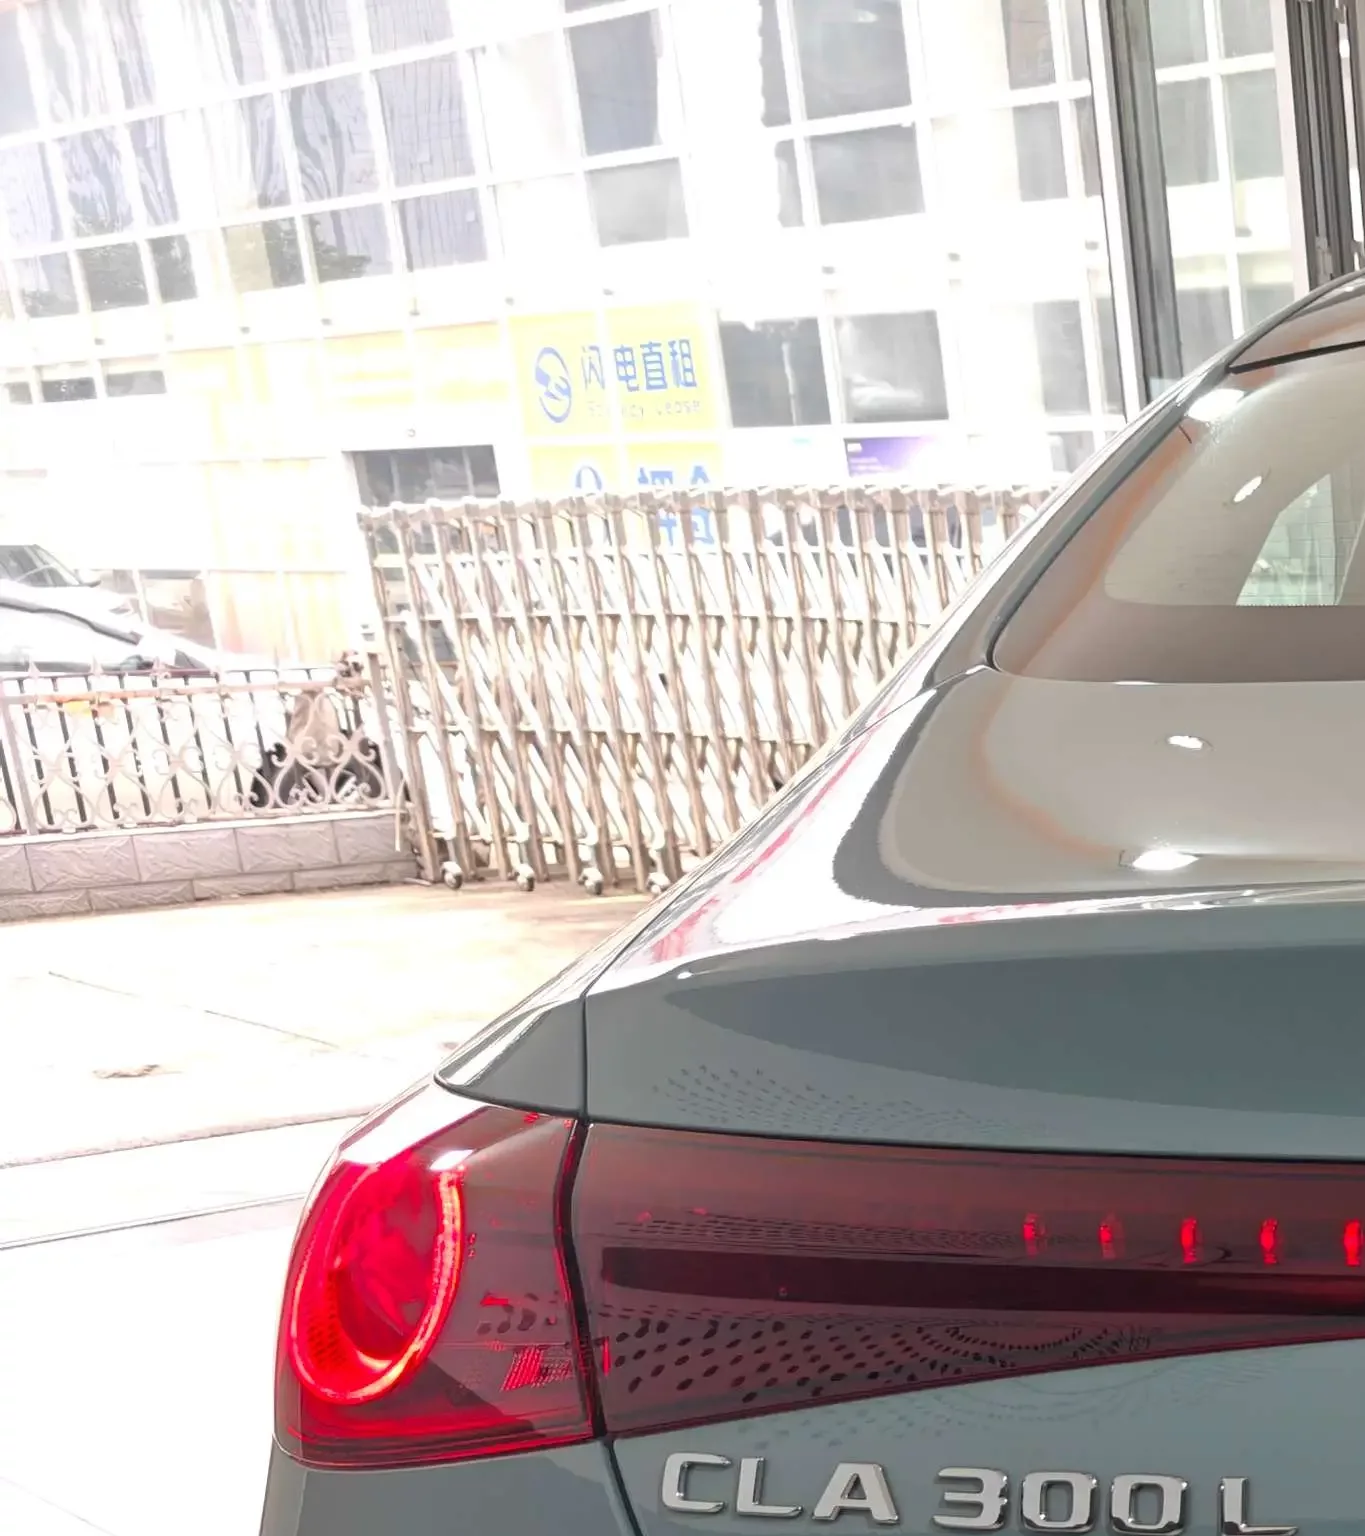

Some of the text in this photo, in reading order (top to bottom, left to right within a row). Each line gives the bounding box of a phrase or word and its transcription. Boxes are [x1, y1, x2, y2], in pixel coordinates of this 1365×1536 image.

[580, 338, 698, 392] 闪电直租
[661, 1453, 900, 1525] CLA
